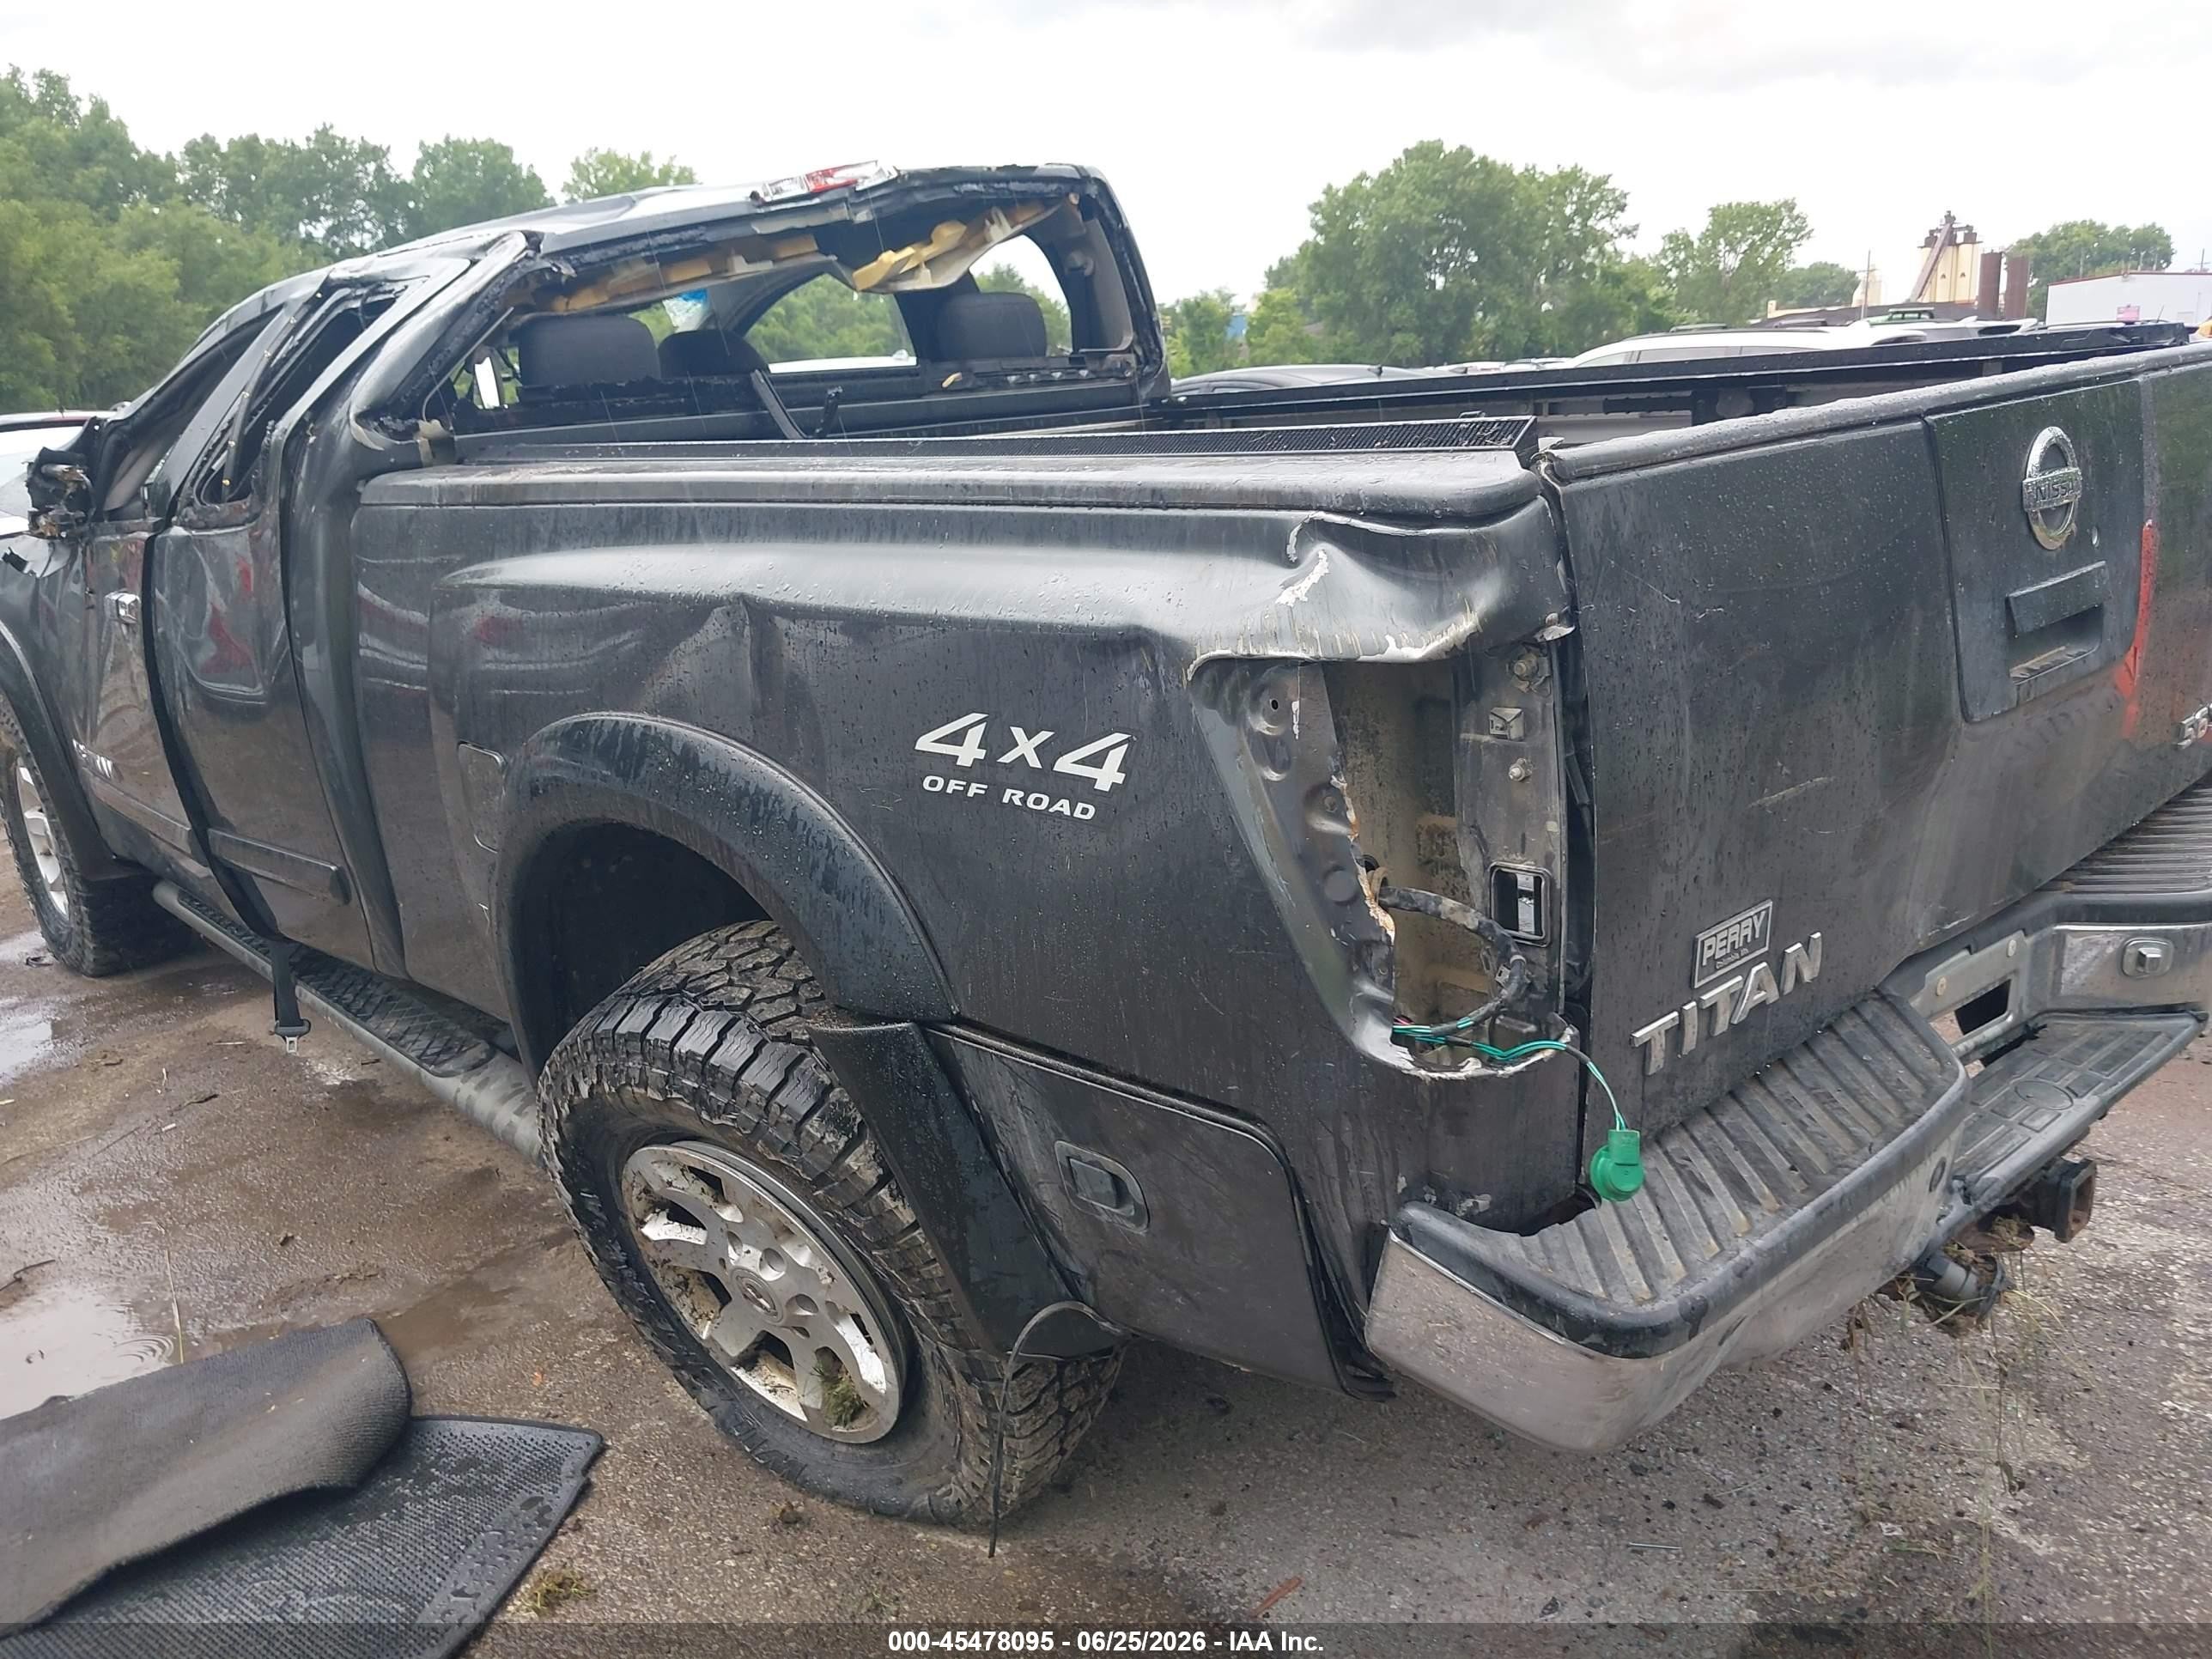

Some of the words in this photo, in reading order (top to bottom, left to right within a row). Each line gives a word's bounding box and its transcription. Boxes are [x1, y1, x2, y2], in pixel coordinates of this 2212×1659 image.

[922, 775, 988, 798] OFF
[1001, 787, 1097, 821] ROAD
[1702, 910, 1766, 967] PERRY
[1631, 931, 1822, 1075] TITAN
